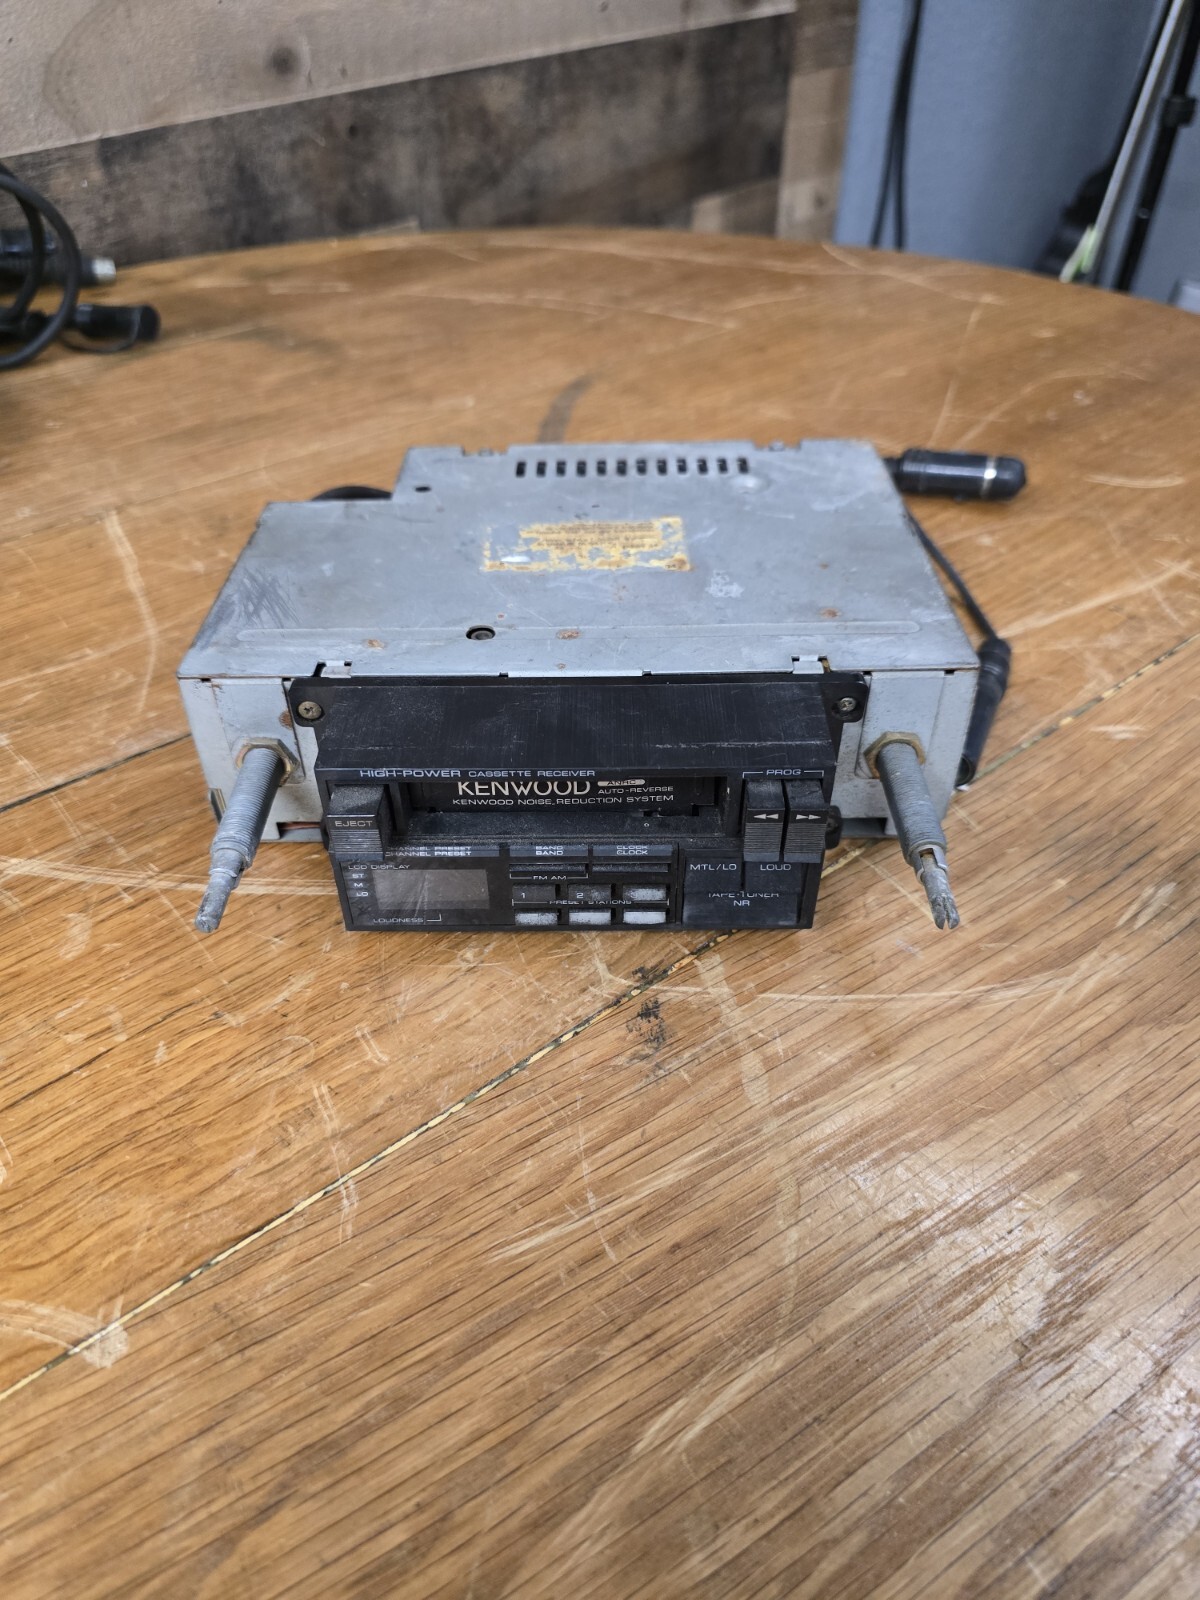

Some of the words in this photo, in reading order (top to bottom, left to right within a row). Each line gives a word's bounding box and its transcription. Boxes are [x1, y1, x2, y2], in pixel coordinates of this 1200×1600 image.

[457, 781, 591, 796] KENWOOD
[598, 786, 674, 794] AUTO-REVERSE
[689, 863, 737, 871] MTL/LO
